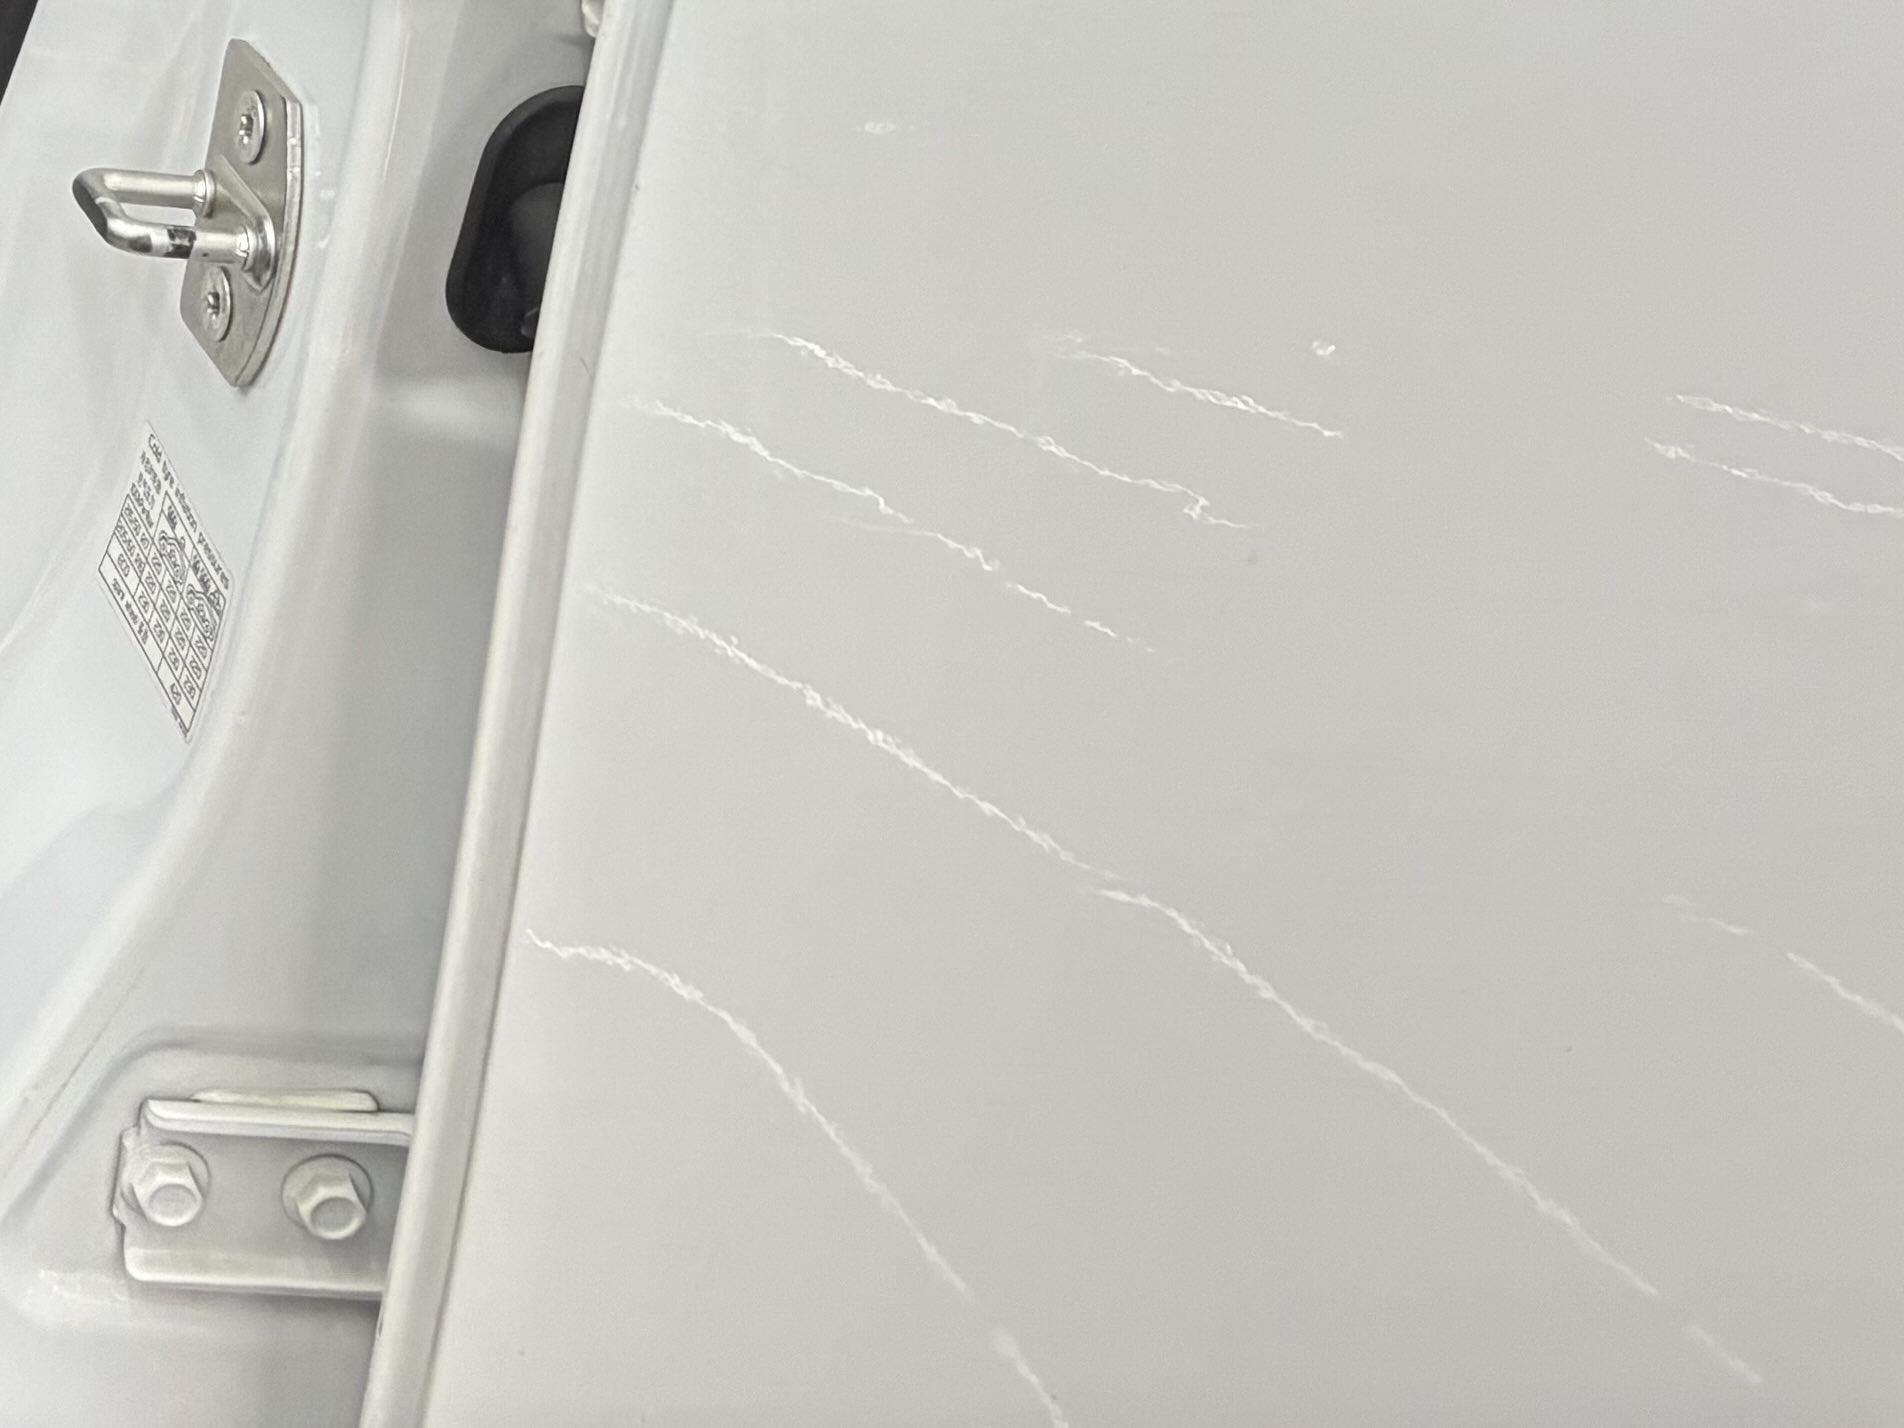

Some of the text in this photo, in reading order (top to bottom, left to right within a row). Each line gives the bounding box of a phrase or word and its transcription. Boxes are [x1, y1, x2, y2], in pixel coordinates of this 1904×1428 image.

[147, 430, 163, 464] Cold
[160, 458, 176, 492] tyre
[174, 483, 198, 534] inflation
[197, 528, 230, 595] pressures
